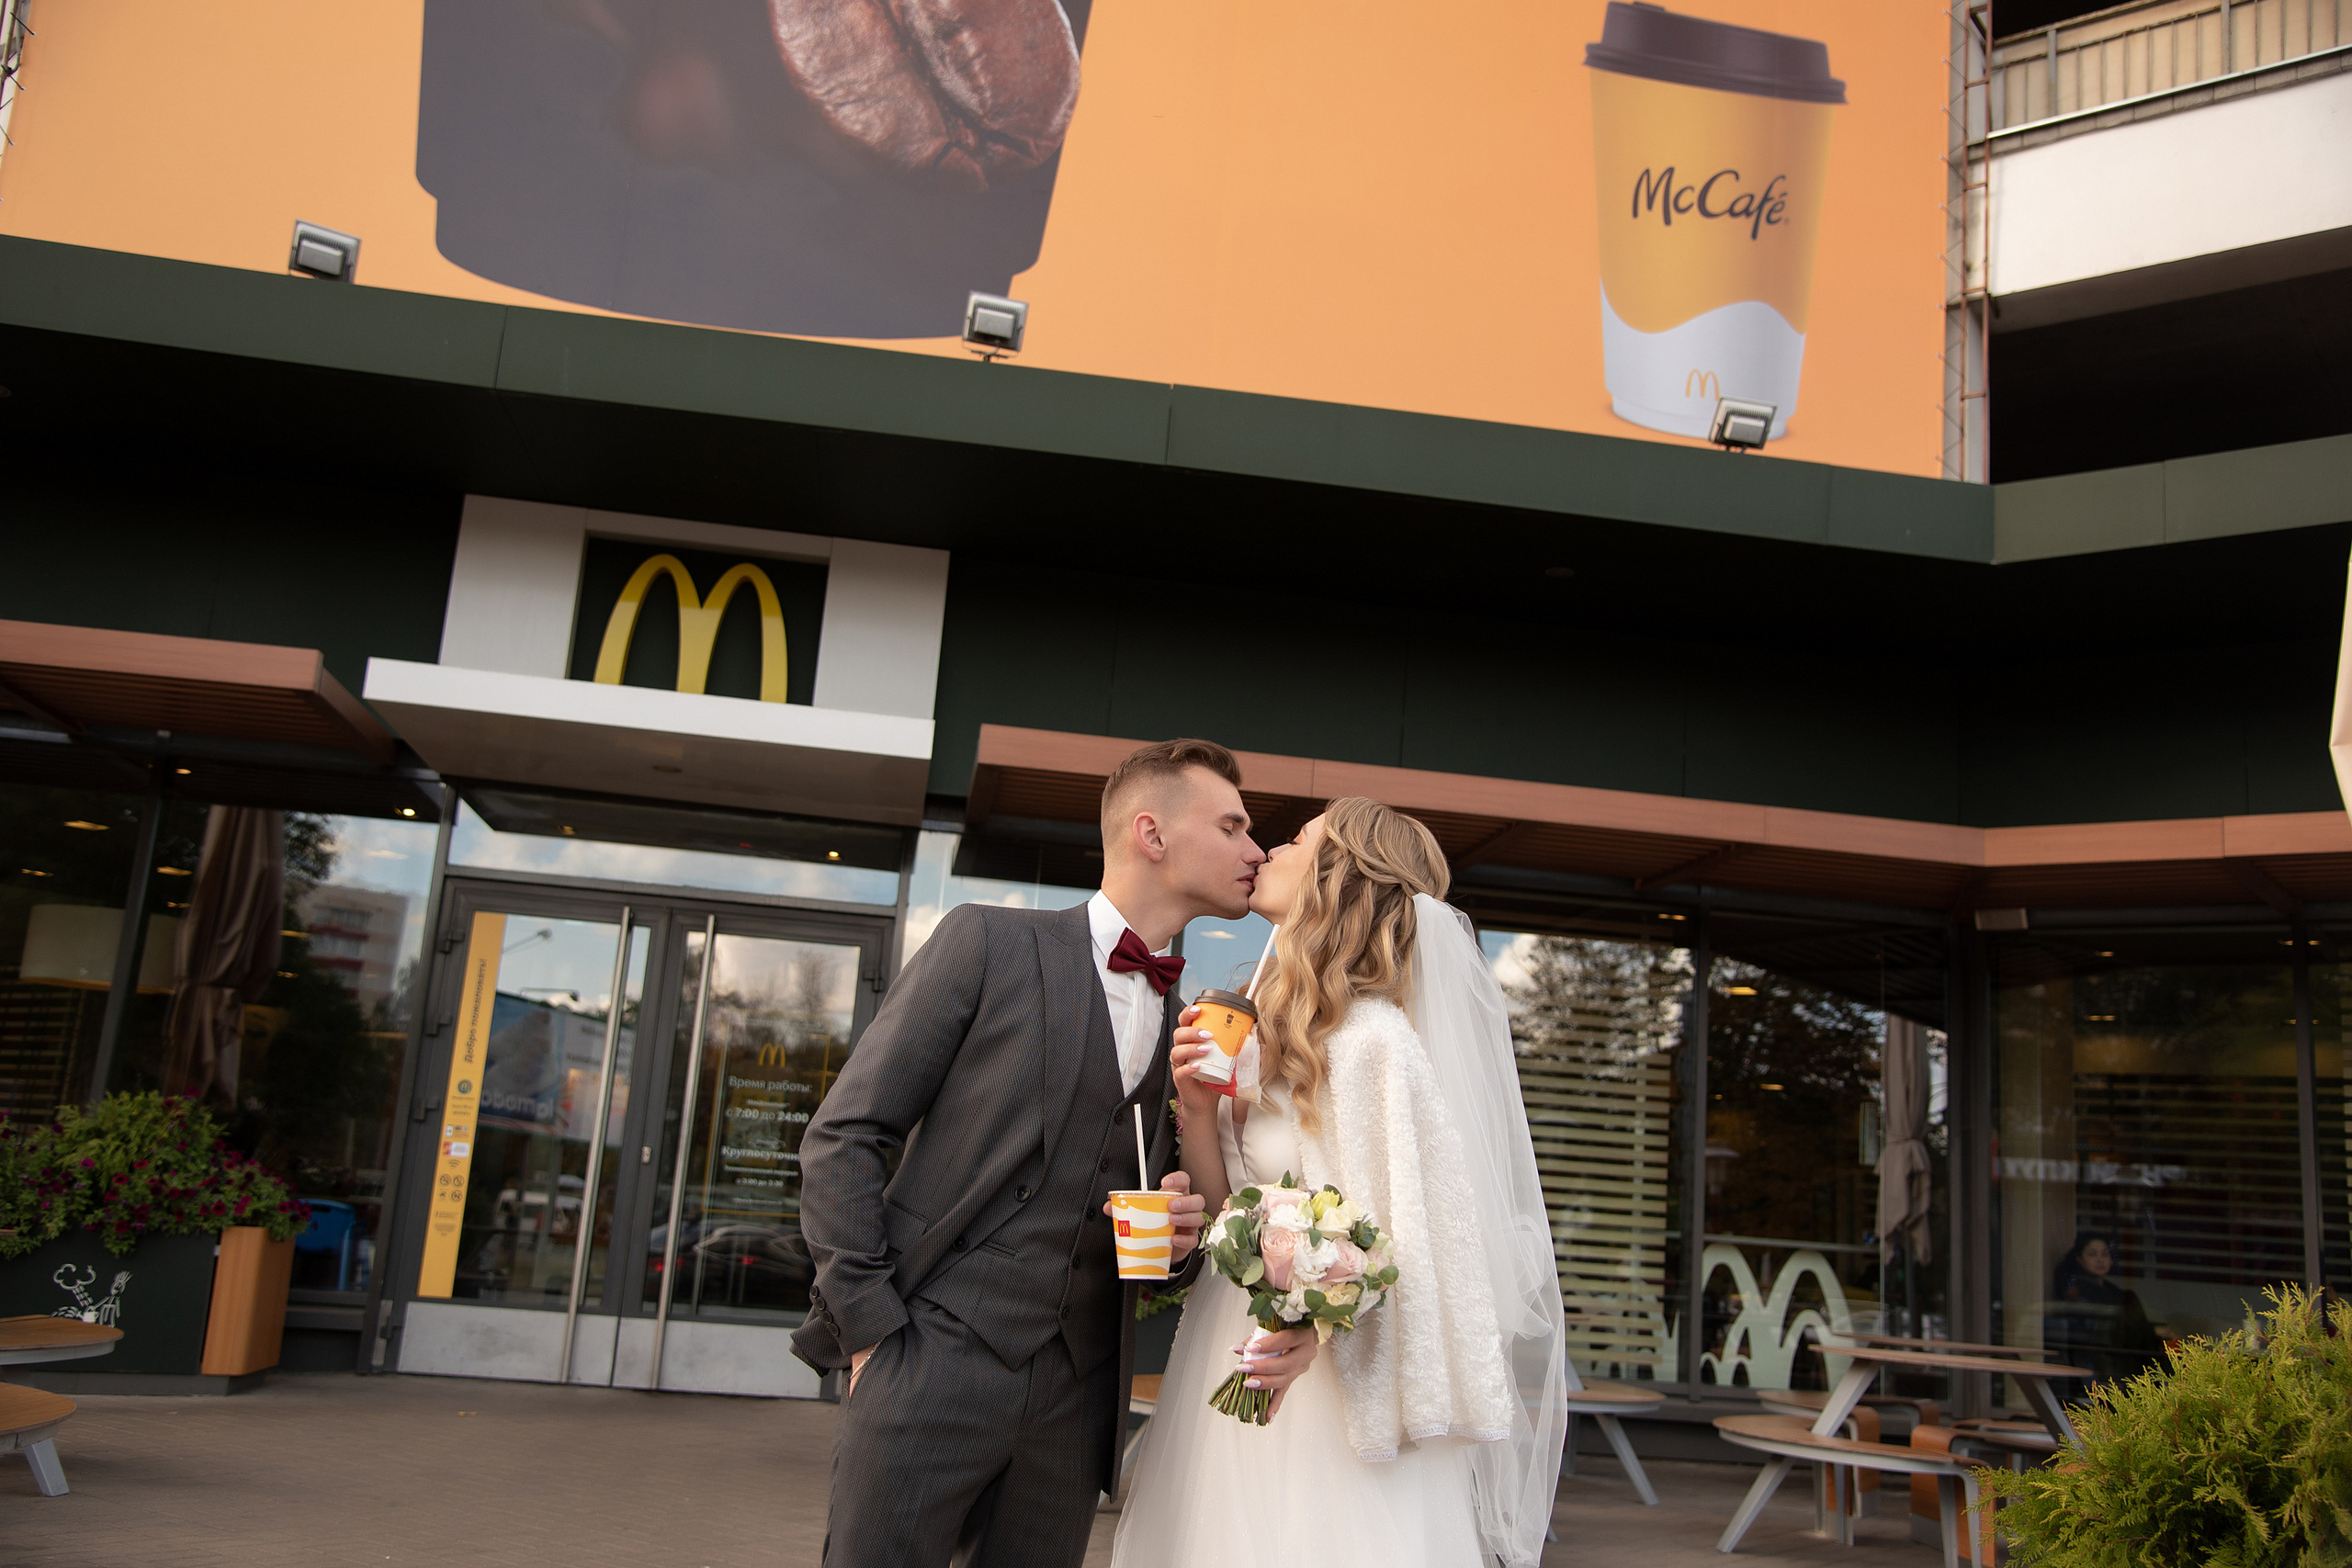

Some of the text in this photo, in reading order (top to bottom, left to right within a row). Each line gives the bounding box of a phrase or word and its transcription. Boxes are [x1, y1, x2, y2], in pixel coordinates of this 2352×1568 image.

[1632, 166, 1789, 241] McCafé
[593, 553, 788, 705] M
[729, 1076, 813, 1093] Время работы:
[734, 1107, 759, 1120] 7:00
[761, 1111, 776, 1122] до
[777, 1111, 809, 1123] 24:00
[722, 1146, 800, 1161] Круглосуточн
